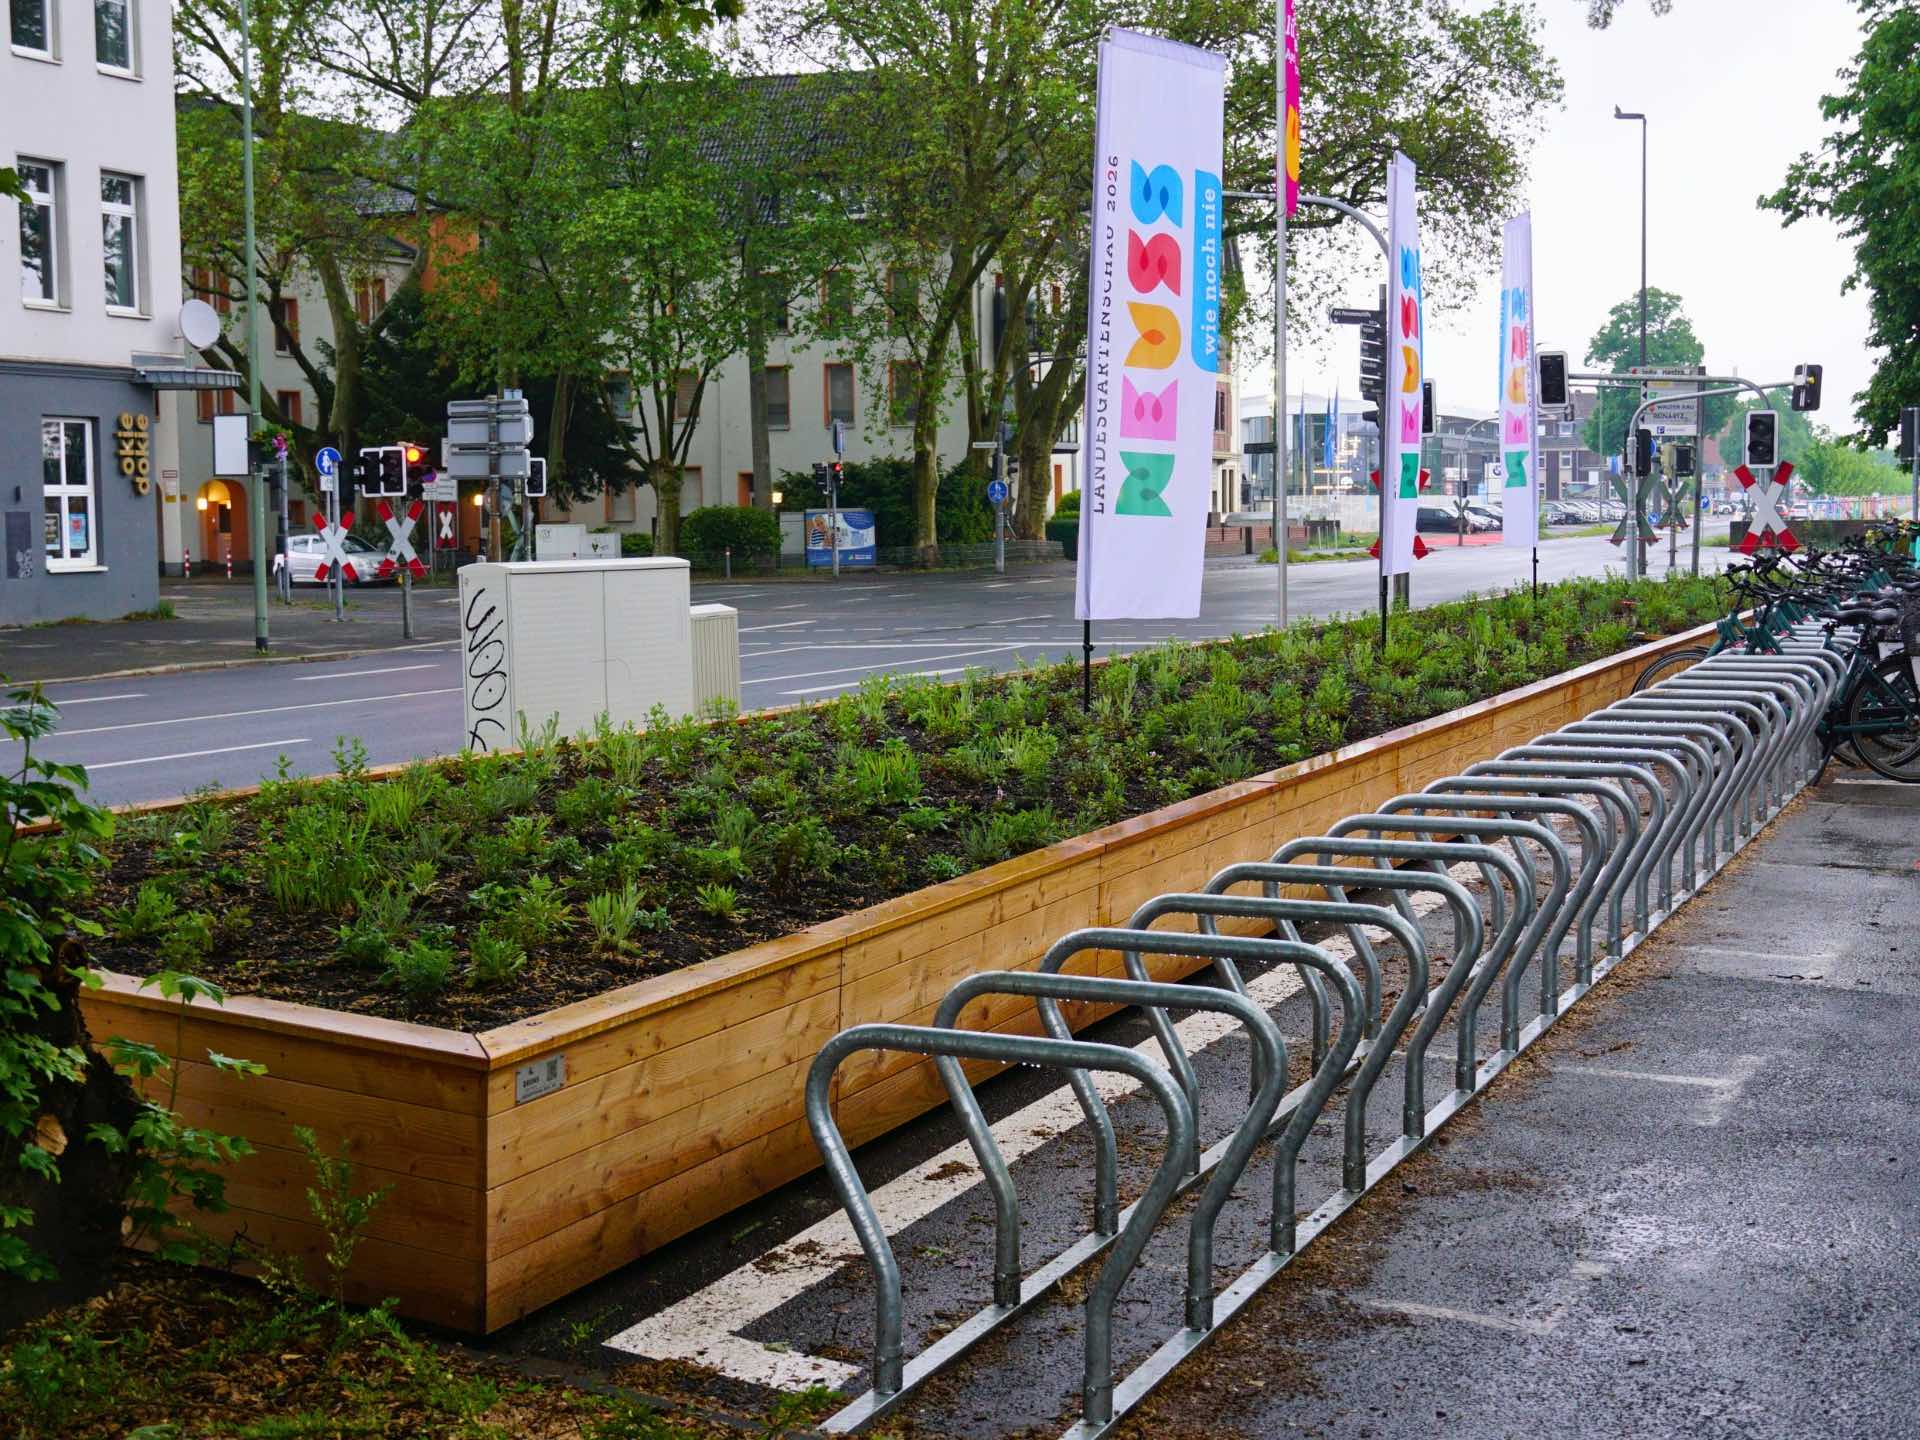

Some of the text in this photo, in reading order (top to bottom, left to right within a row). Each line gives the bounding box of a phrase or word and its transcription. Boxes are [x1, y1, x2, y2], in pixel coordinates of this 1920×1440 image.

[1093, 155, 1119, 514] LANDESGARTENSCHAU 2026
[1115, 158, 1184, 517] NEUSS
[1200, 188, 1217, 356] wie noch nie
[118, 412, 134, 475] okie
[136, 414, 149, 495] dokie
